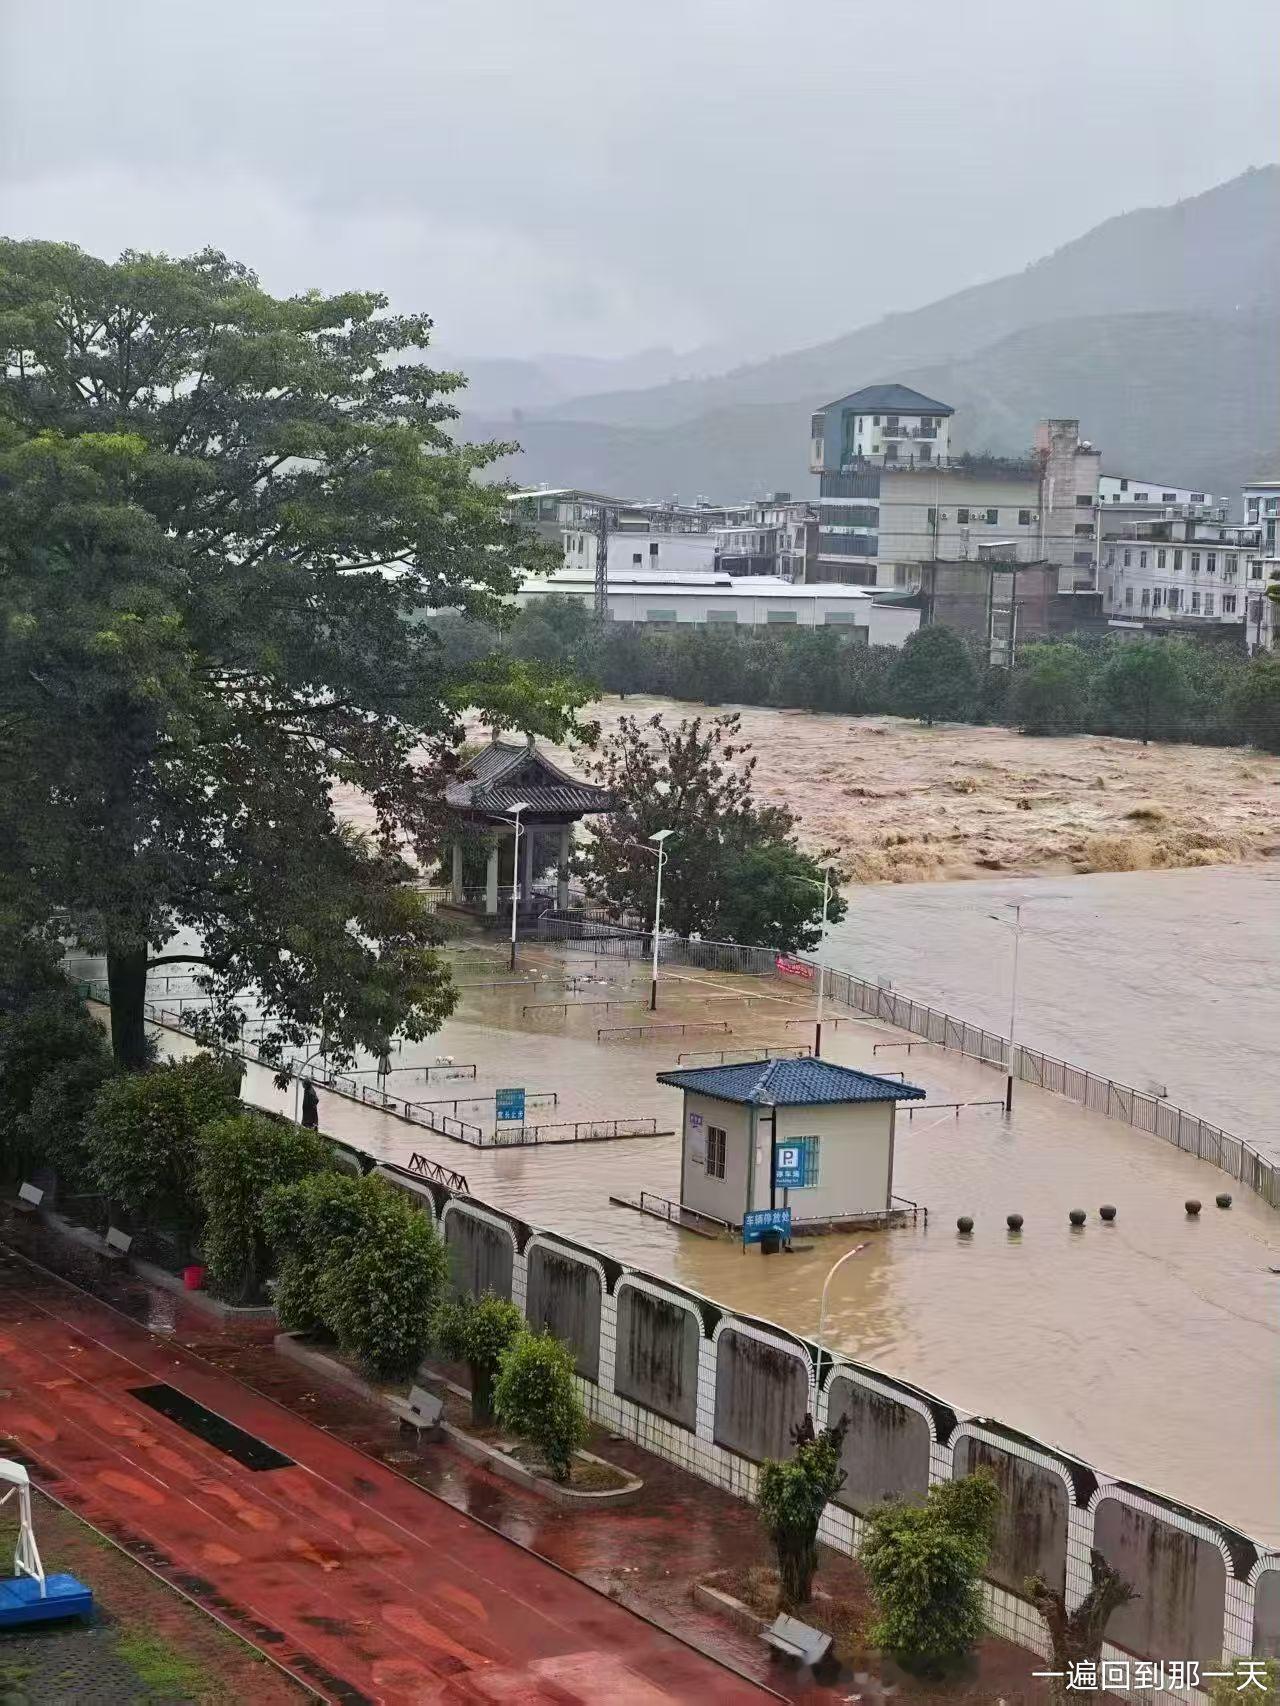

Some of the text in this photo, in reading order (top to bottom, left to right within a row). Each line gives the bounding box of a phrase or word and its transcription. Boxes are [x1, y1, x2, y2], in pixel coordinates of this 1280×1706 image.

[783, 1151, 793, 1165] P
[746, 1212, 789, 1225] 车辆停放处
